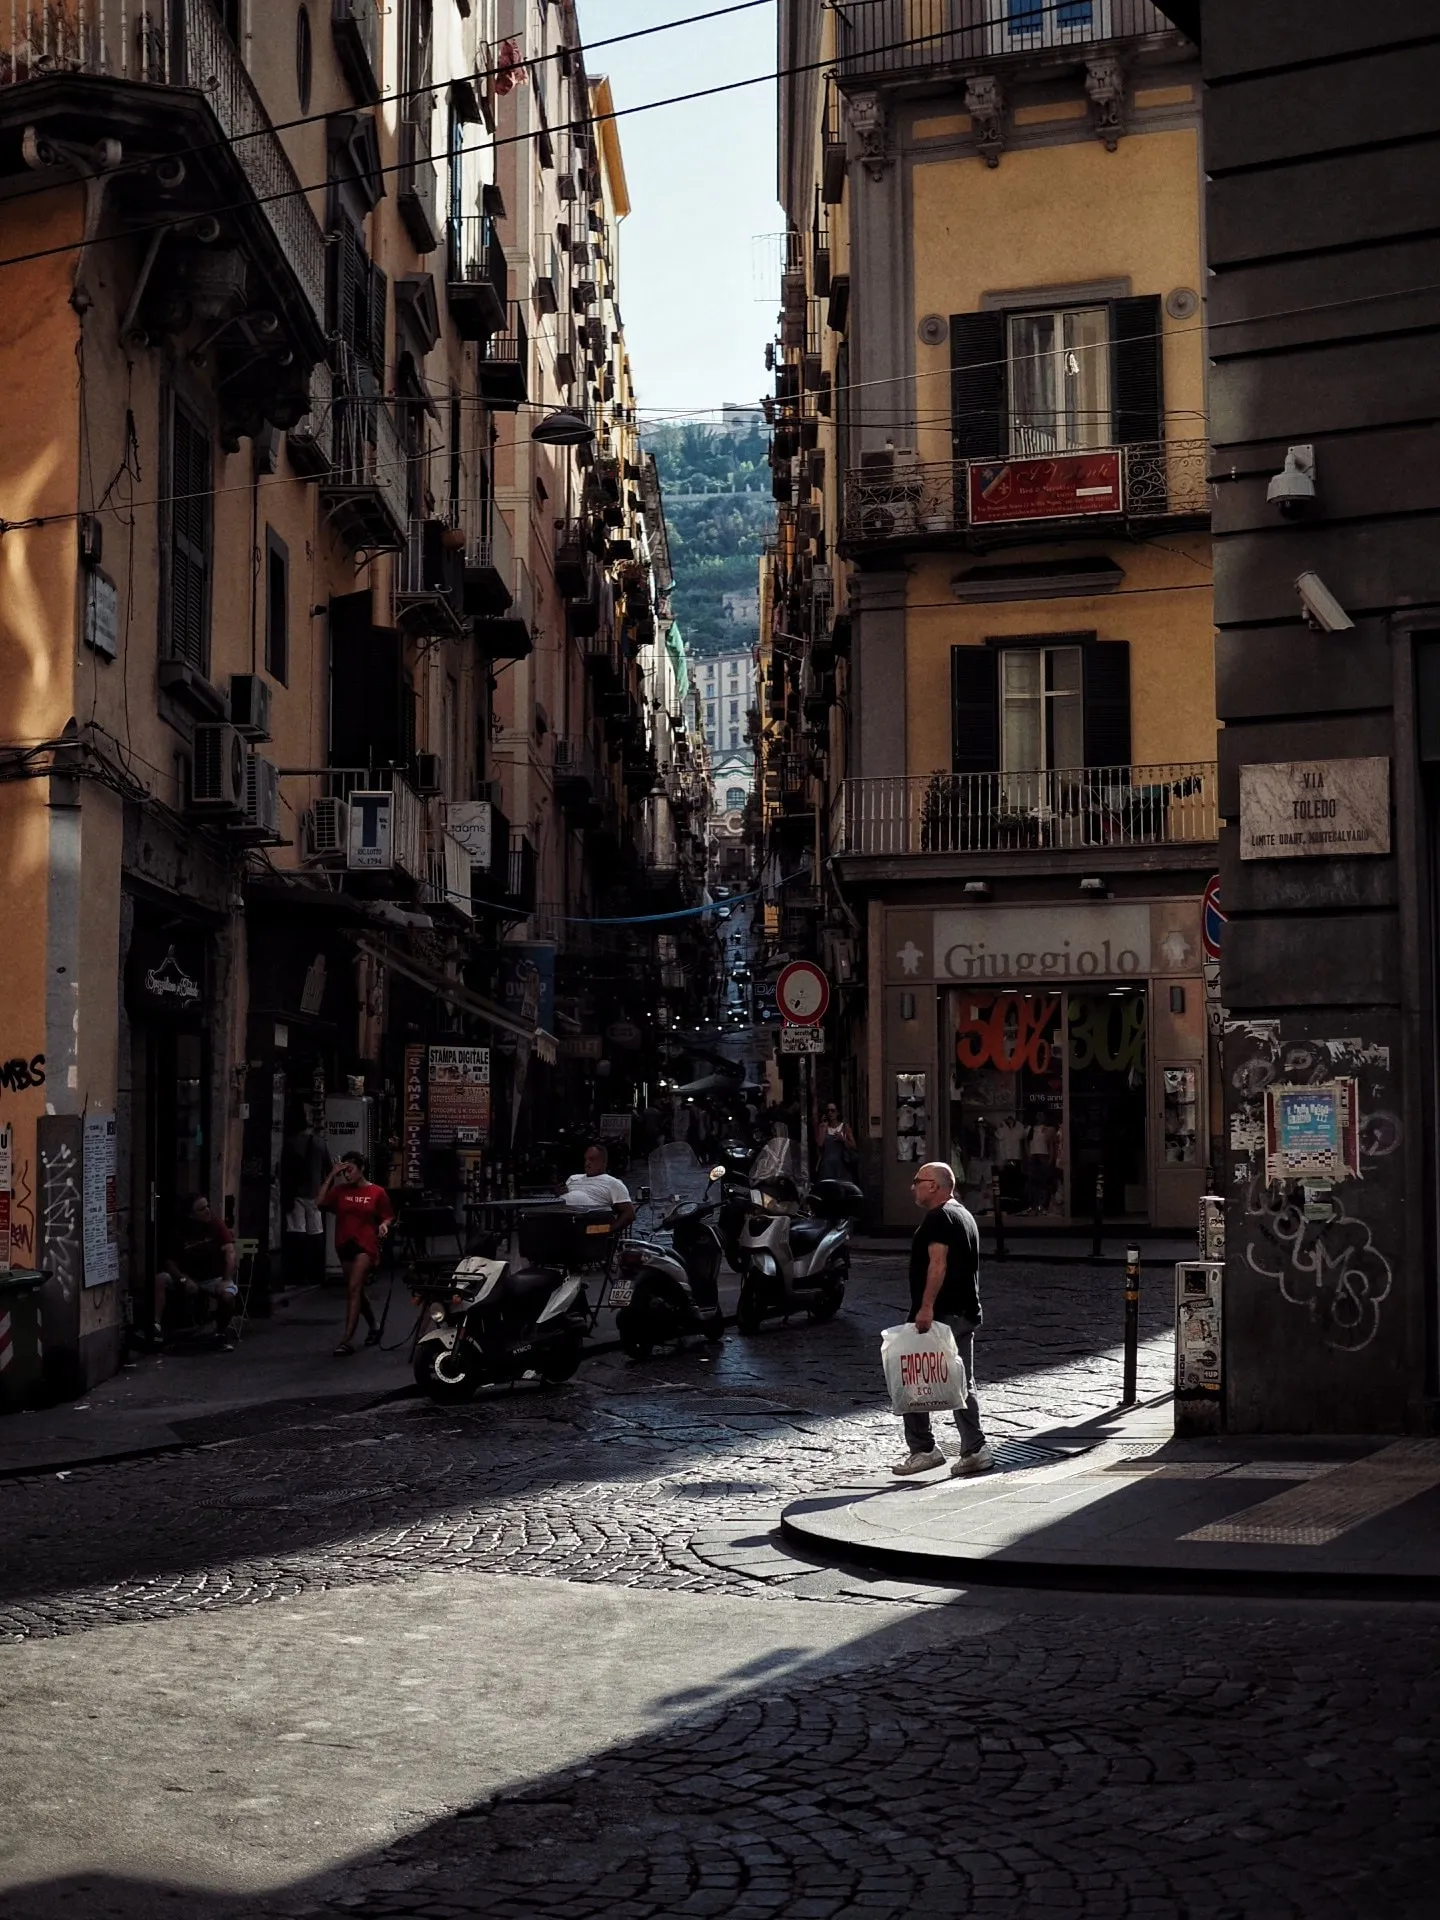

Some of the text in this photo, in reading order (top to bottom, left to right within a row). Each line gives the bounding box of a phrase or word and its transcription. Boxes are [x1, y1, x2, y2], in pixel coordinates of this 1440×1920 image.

[1302, 772, 1325, 789] VIA
[352, 797, 389, 847] T
[1291, 799, 1337, 820] TOLEDO
[1251, 832, 1276, 847] LIMITE
[944, 939, 1140, 979] Giuggiolo
[956, 992, 1061, 1076] 50%
[430, 1049, 489, 1065] STAMPA DIGITALE
[407, 1057, 422, 1179] STAMPA DIGITALE
[900, 1351, 949, 1386] EMPORIO
